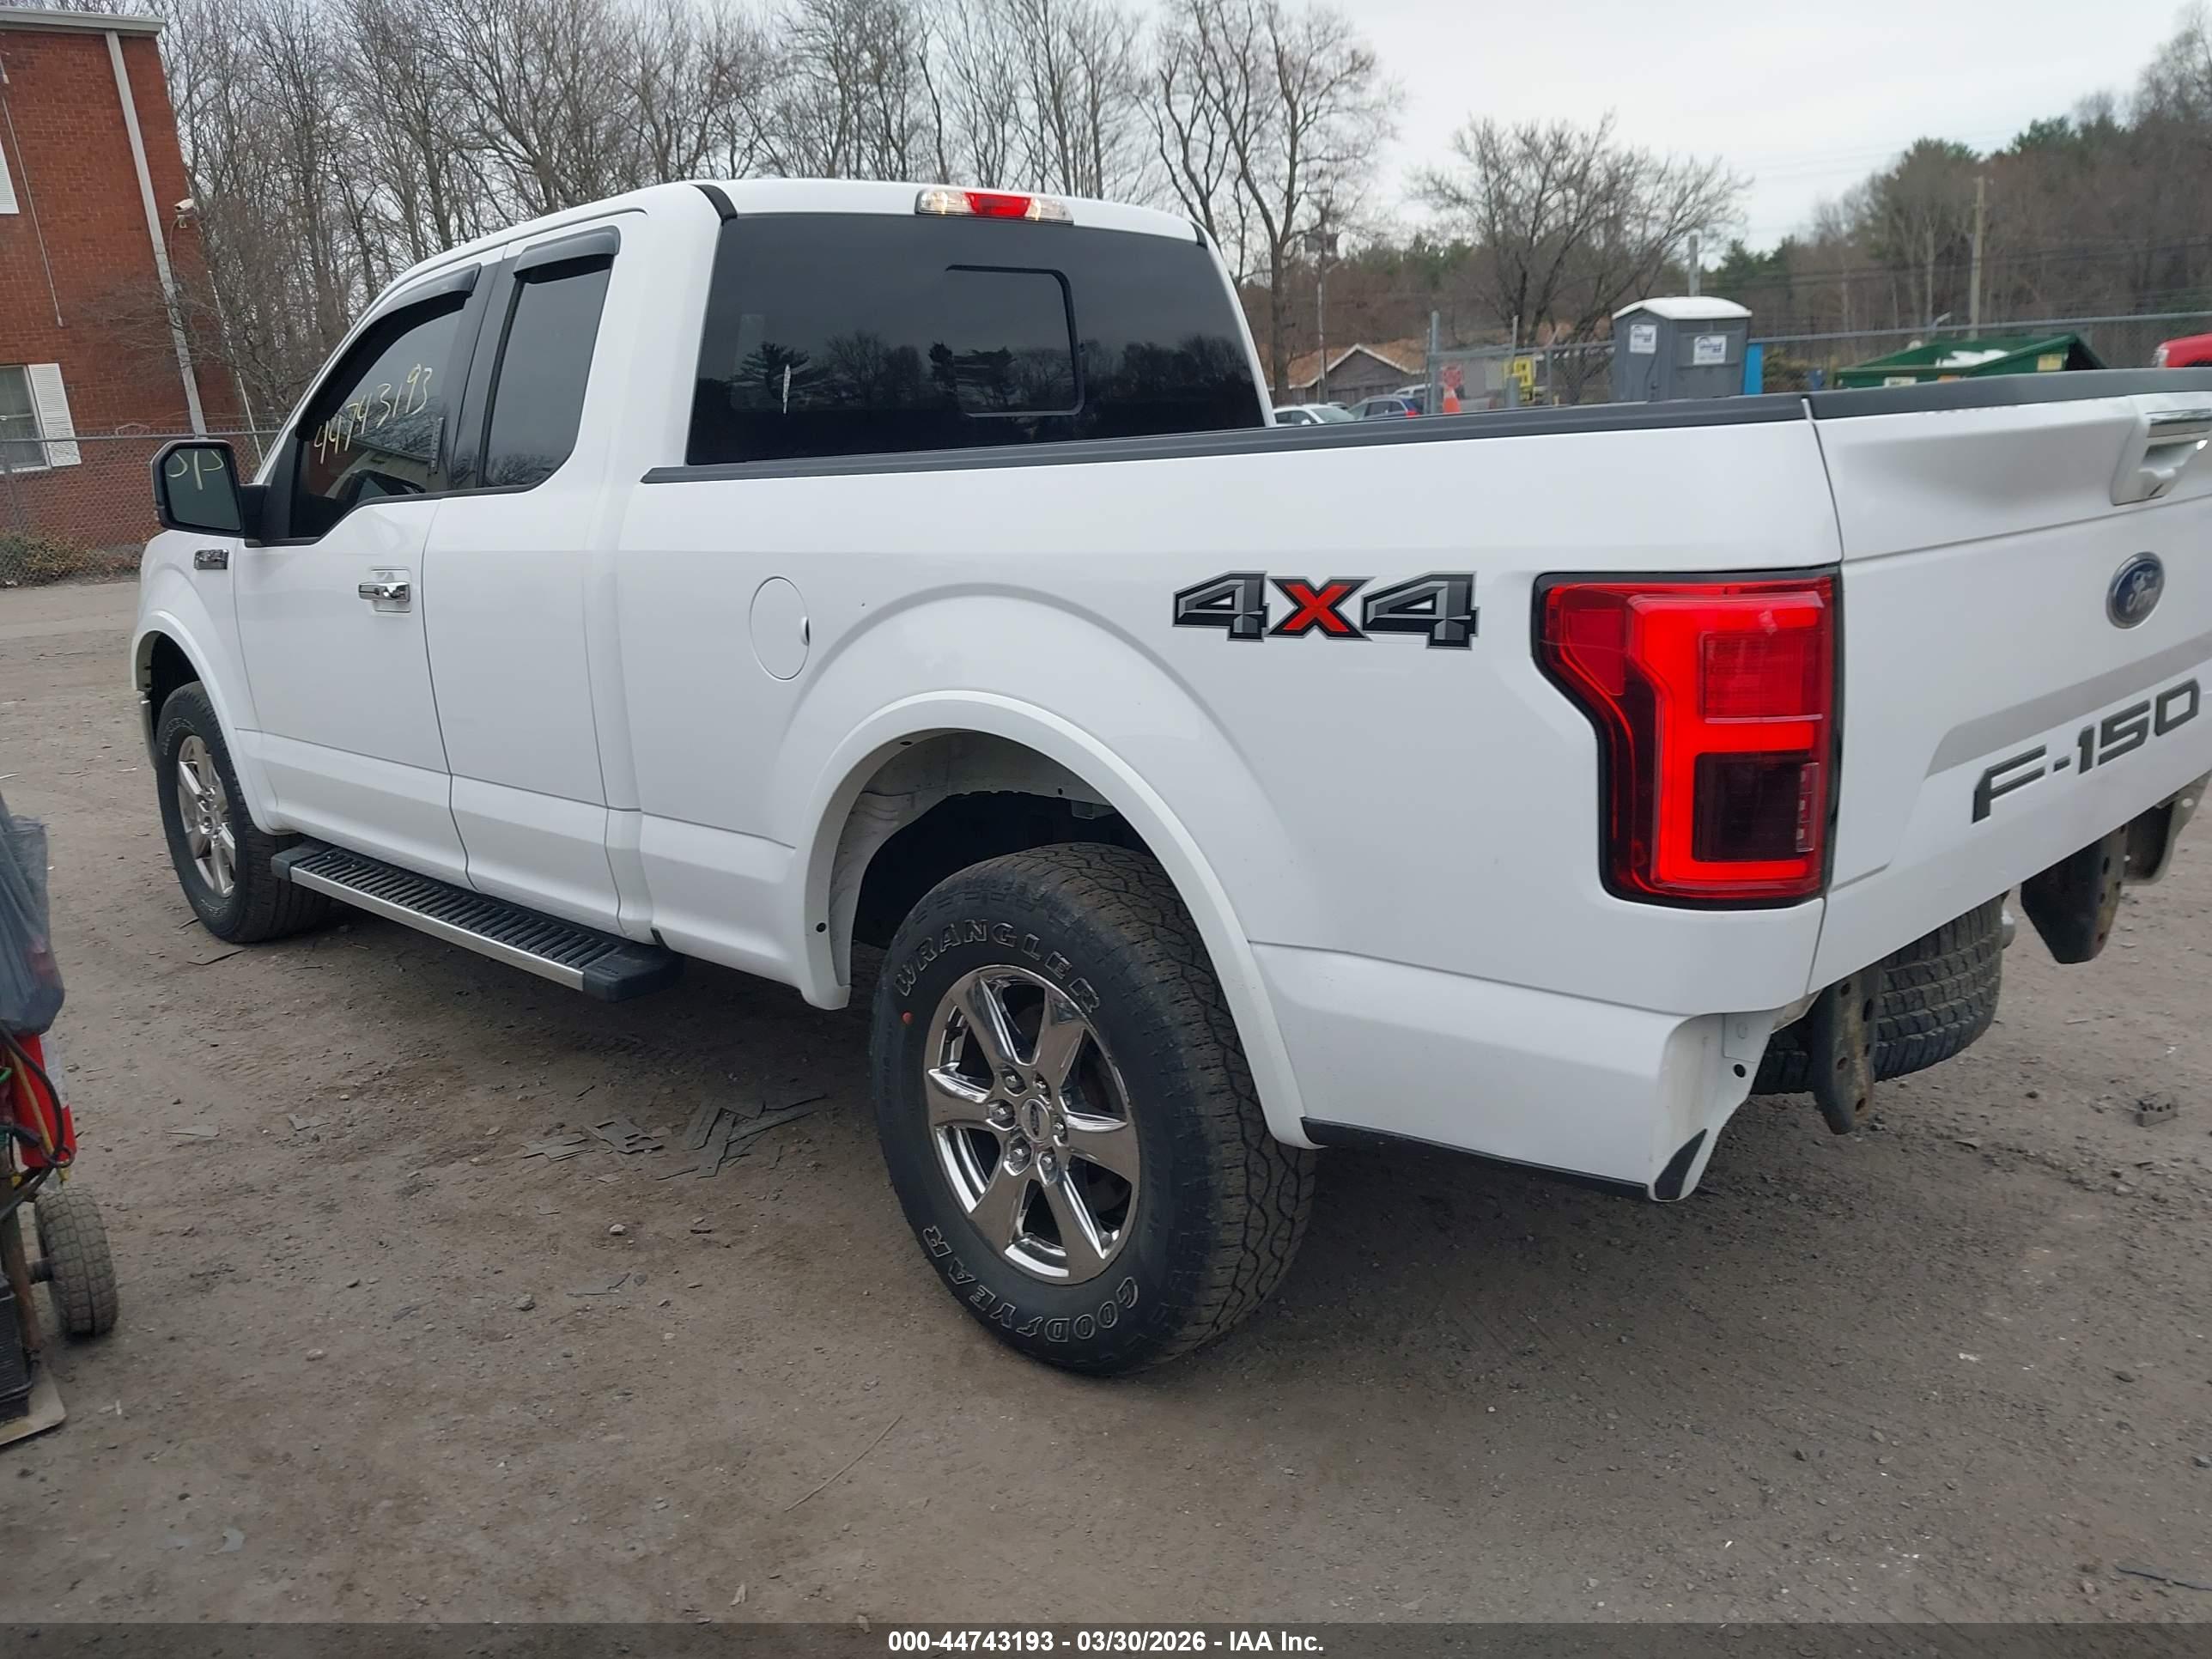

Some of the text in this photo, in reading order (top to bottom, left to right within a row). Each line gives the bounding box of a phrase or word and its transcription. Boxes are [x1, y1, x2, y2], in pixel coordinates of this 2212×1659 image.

[313, 362, 434, 465] 44743193
[1972, 678, 2201, 824] F-150
[894, 919, 1102, 1014] WRANGLER
[921, 1223, 1139, 1344] GOODYEAR
